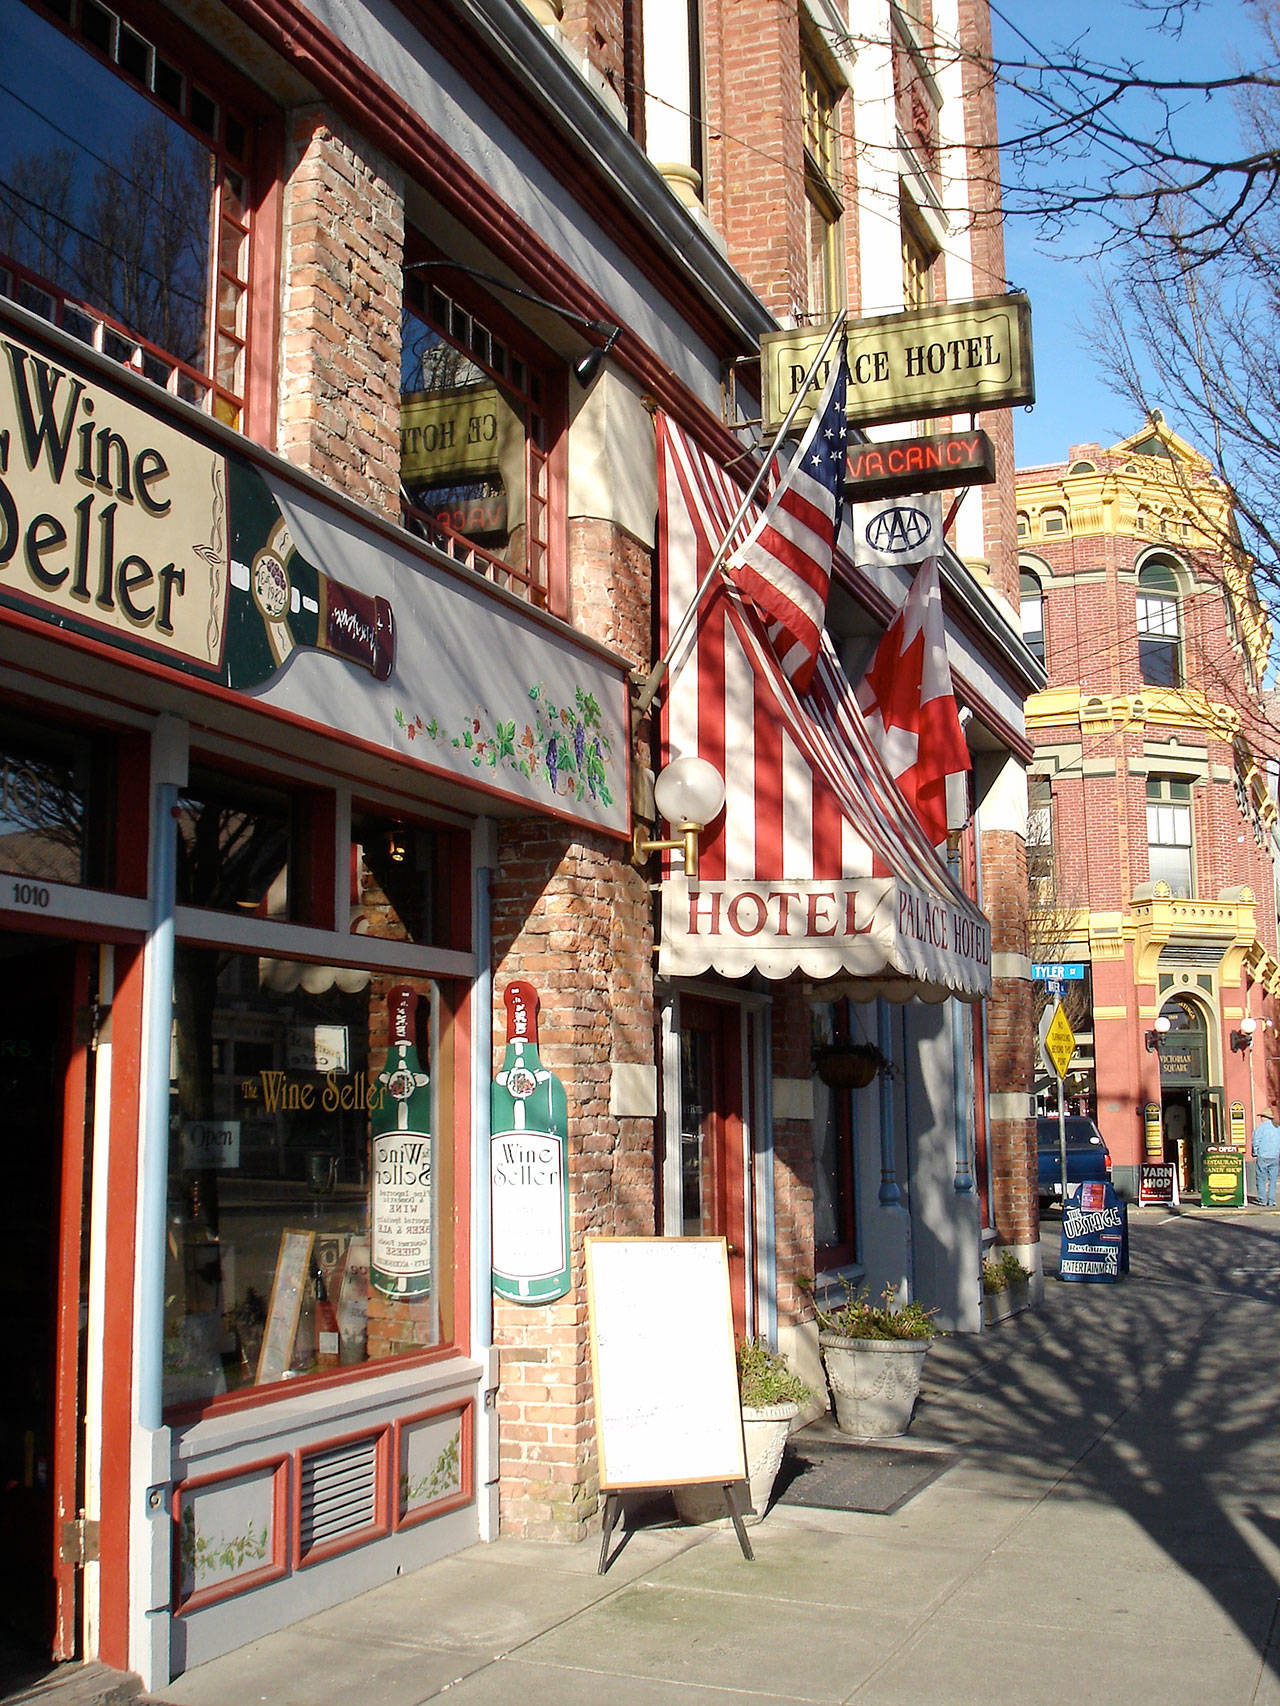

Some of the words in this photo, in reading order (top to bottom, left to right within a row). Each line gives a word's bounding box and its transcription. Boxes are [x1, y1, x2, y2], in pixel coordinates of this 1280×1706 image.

[904, 335, 1001, 378] HOTEL
[2, 338, 172, 520] Wine
[847, 438, 979, 478] VACANCY
[874, 513, 924, 550] AAA
[13, 883, 50, 908] 1010
[686, 891, 875, 938] HOTEL
[899, 890, 949, 950] PALACE
[954, 914, 989, 966] HOTEL
[1035, 966, 1064, 979] TYLER
[1160, 1055, 1192, 1064] VICTORIAN
[1163, 1064, 1188, 1072] SQUARE
[241, 1079, 259, 1099] The
[259, 1070, 316, 1113] Wine
[321, 1068, 388, 1112] Seller
[502, 1143, 553, 1164] Wine
[493, 1162, 558, 1187] Seller
[1142, 1167, 1173, 1178] YARN
[1143, 1178, 1171, 1189] SHOP
[1064, 1208, 1121, 1238] UPSTAGE
[1062, 1260, 1117, 1275] ENTERTAINMENT
